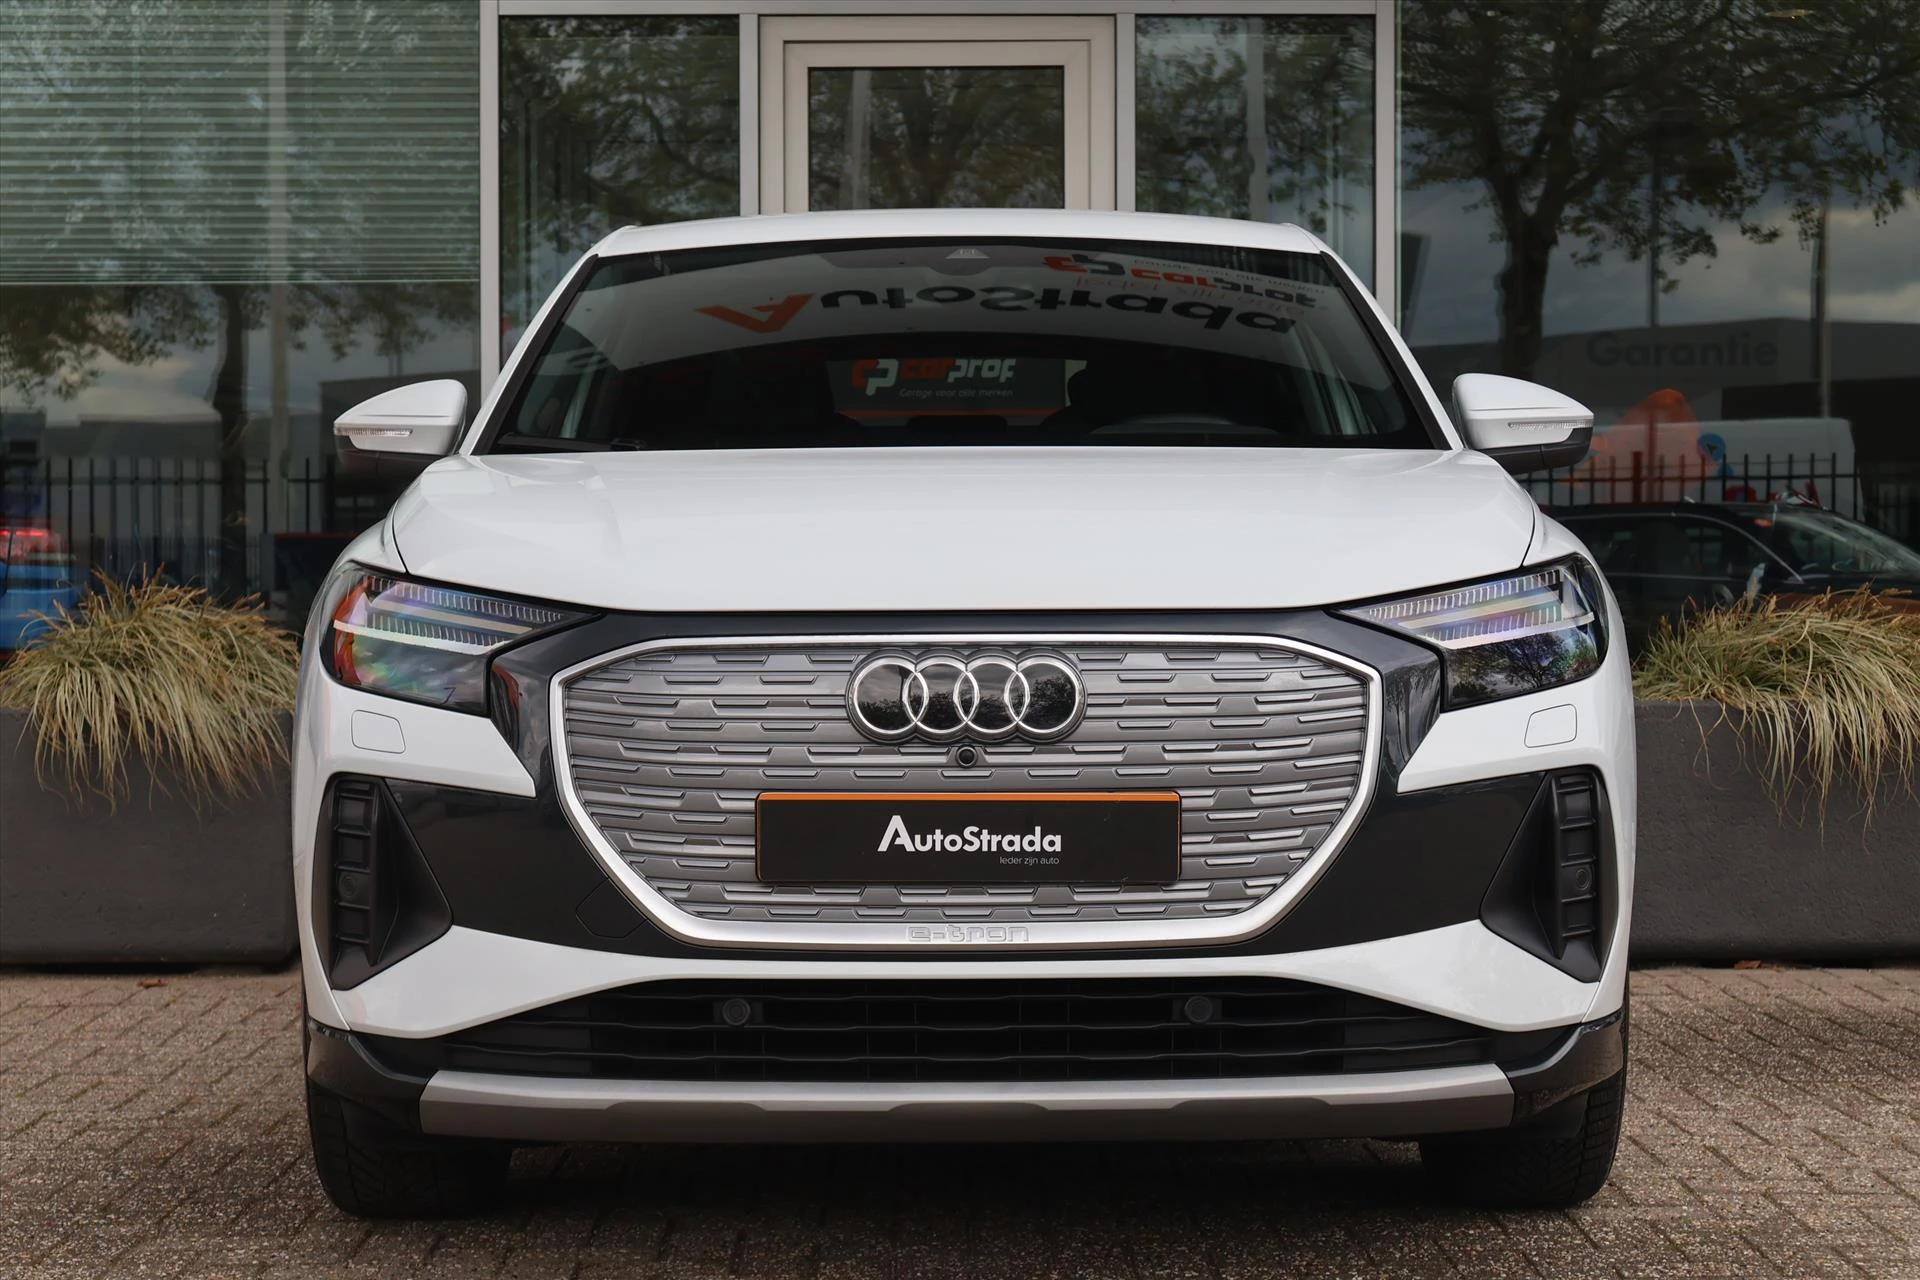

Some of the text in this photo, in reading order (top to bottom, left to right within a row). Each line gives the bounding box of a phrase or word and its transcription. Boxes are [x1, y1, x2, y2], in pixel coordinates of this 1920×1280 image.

[1587, 331, 1778, 367] Garantie
[899, 388, 932, 400] Garage
[934, 390, 956, 398] voor
[978, 388, 1014, 398] merken
[877, 815, 1062, 852] AutoStrada
[1023, 856, 1039, 867] zijn
[1040, 856, 1060, 865] auto
[908, 924, 1029, 942] e-tron
